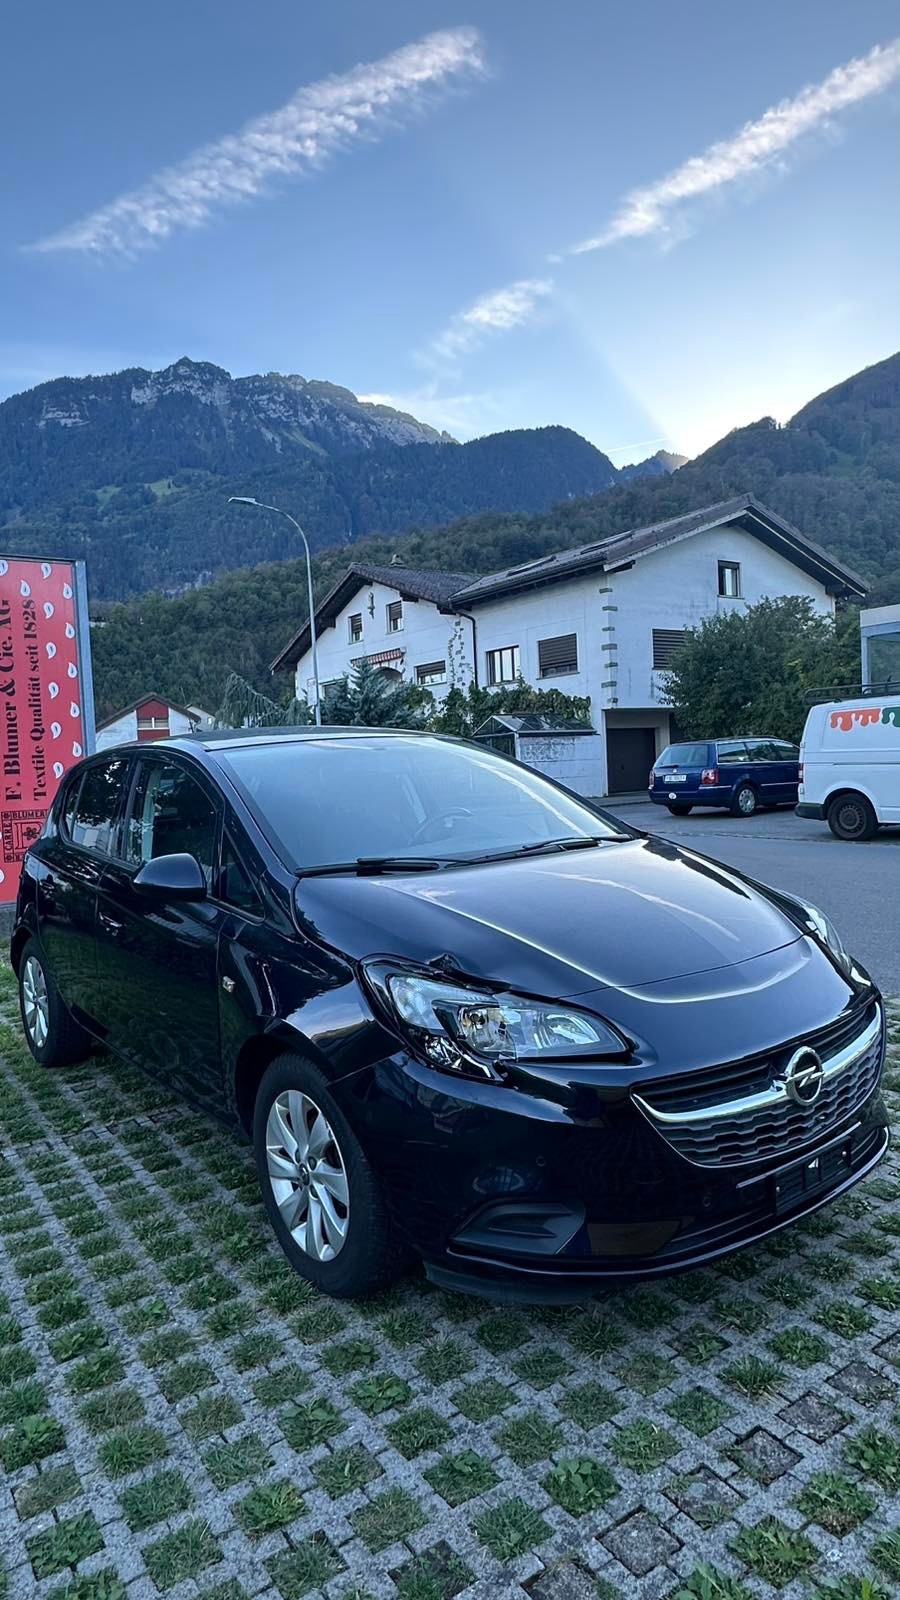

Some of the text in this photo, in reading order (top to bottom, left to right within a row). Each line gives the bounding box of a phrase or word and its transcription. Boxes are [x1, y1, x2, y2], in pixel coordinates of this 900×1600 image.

[0, 599, 22, 801] F. Blumer & Cie. AG
[22, 599, 47, 801] Textile Qualität seit 1828
